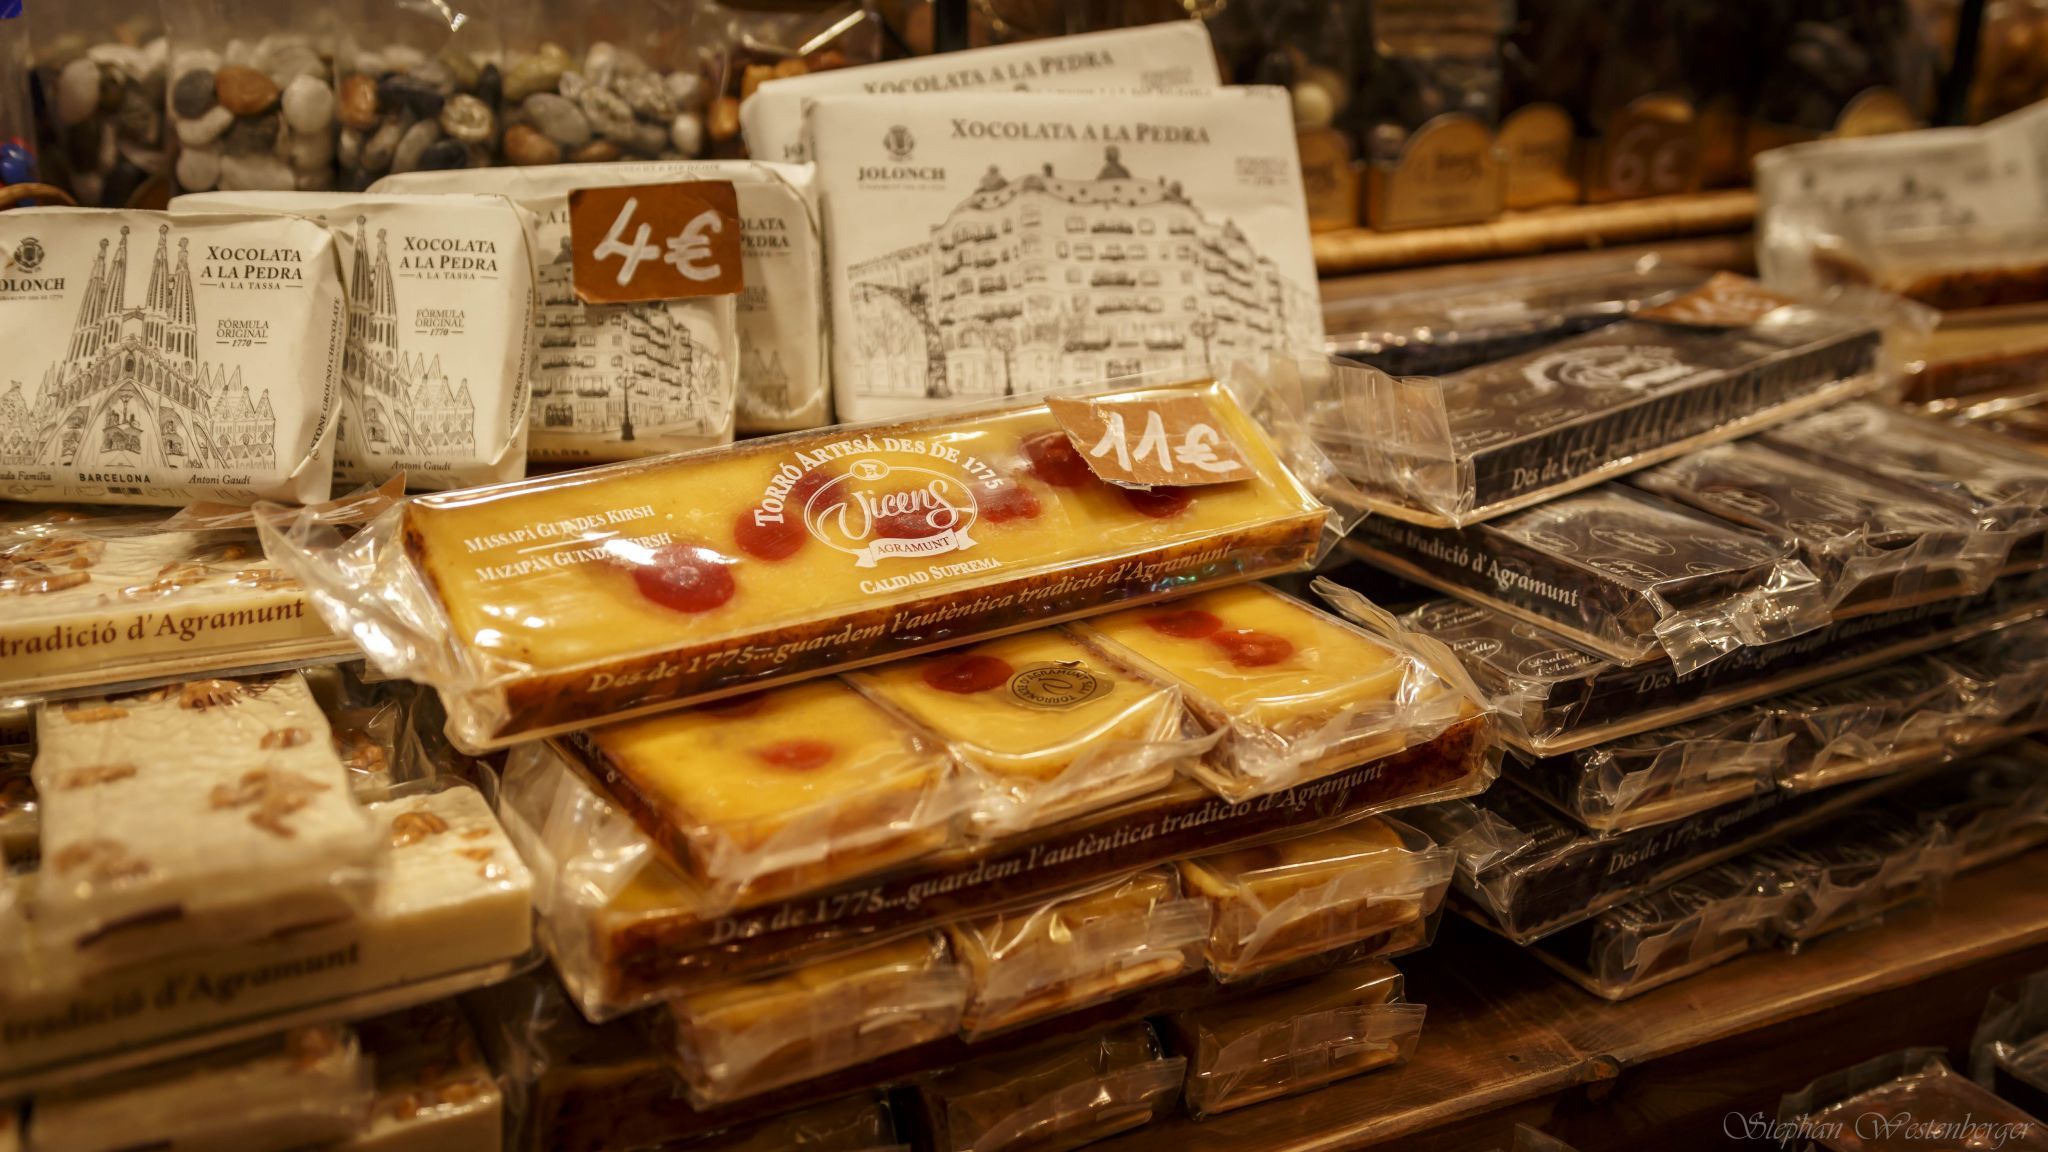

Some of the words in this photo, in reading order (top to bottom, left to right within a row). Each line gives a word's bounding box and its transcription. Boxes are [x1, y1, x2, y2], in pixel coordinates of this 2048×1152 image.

[951, 118, 1077, 141] XOCOLATA
[1079, 123, 1097, 141] A
[1103, 123, 1130, 142] LA
[1136, 122, 1211, 145] PEDRA
[858, 166, 946, 181] JOLONCH
[403, 236, 496, 253] XOCOLATA
[593, 197, 722, 286] 4€
[206, 246, 302, 262] XOCOLATA
[400, 256, 410, 269] A
[415, 256, 434, 269] LA
[440, 255, 498, 271] PEDRA
[200, 265, 212, 278] A
[217, 266, 239, 279] LA
[244, 265, 303, 280] PEDRA
[0, 277, 65, 292] OLONCH
[248, 282, 281, 290] TASSA
[216, 329, 268, 338] ORIGINAL
[320, 364, 334, 411] GROUND
[328, 296, 341, 363] CHOCOLATE
[1090, 409, 1243, 473] 11€
[79, 472, 150, 485] BARCELONA
[188, 474, 219, 485] Antoni
[753, 461, 803, 527] TORRÓ
[795, 434, 881, 471] ARTESÀ
[882, 438, 927, 455] DES
[928, 441, 960, 463] DE
[961, 456, 1005, 490] 1775
[605, 505, 655, 524] KIRSH
[817, 479, 960, 541] Vicens
[876, 536, 950, 555] AGRAMUNT
[859, 570, 929, 594] CALIDAD
[928, 556, 1002, 580] SUPREMA
[1018, 567, 1105, 603] tradició
[1107, 542, 1233, 585] d'Agramunt
[1472, 553, 1578, 607] d'Agramunt
[0, 619, 117, 658] tradició
[127, 598, 304, 642] d'Agramunt
[1027, 822, 1155, 871] l'autèntica
